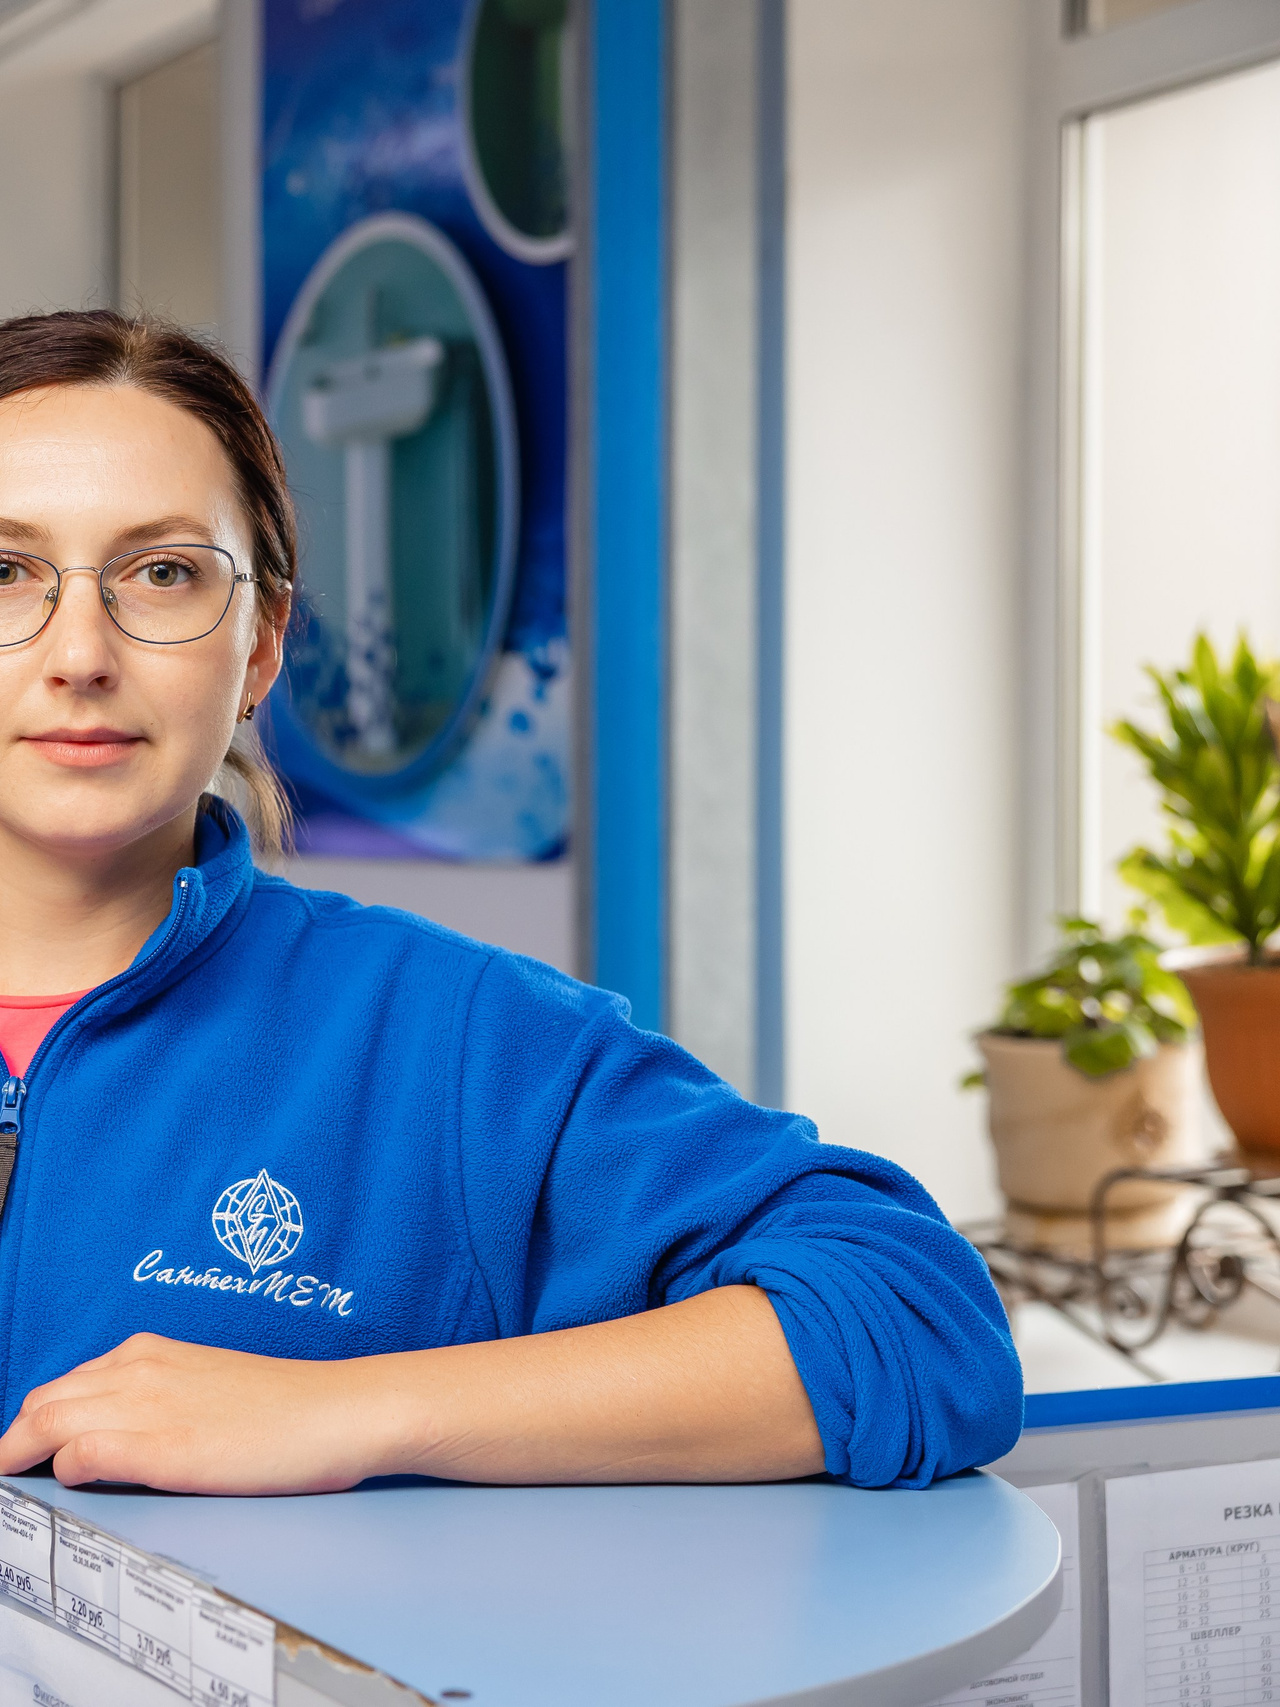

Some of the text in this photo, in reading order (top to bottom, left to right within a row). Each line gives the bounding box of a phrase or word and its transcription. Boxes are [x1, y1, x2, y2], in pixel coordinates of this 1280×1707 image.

[1224, 1503, 1273, 1521] РЕЗКА
[1168, 1541, 1260, 1561] АРМАТУРА (КРУГ)
[16, 1574, 34, 1592] руб.
[71, 1597, 87, 1618] 2,20
[88, 1610, 105, 1628] руб.
[1190, 1626, 1242, 1641] ШВЕЛЛЕР
[136, 1633, 154, 1655] 3,70
[155, 1647, 173, 1667] руб.
